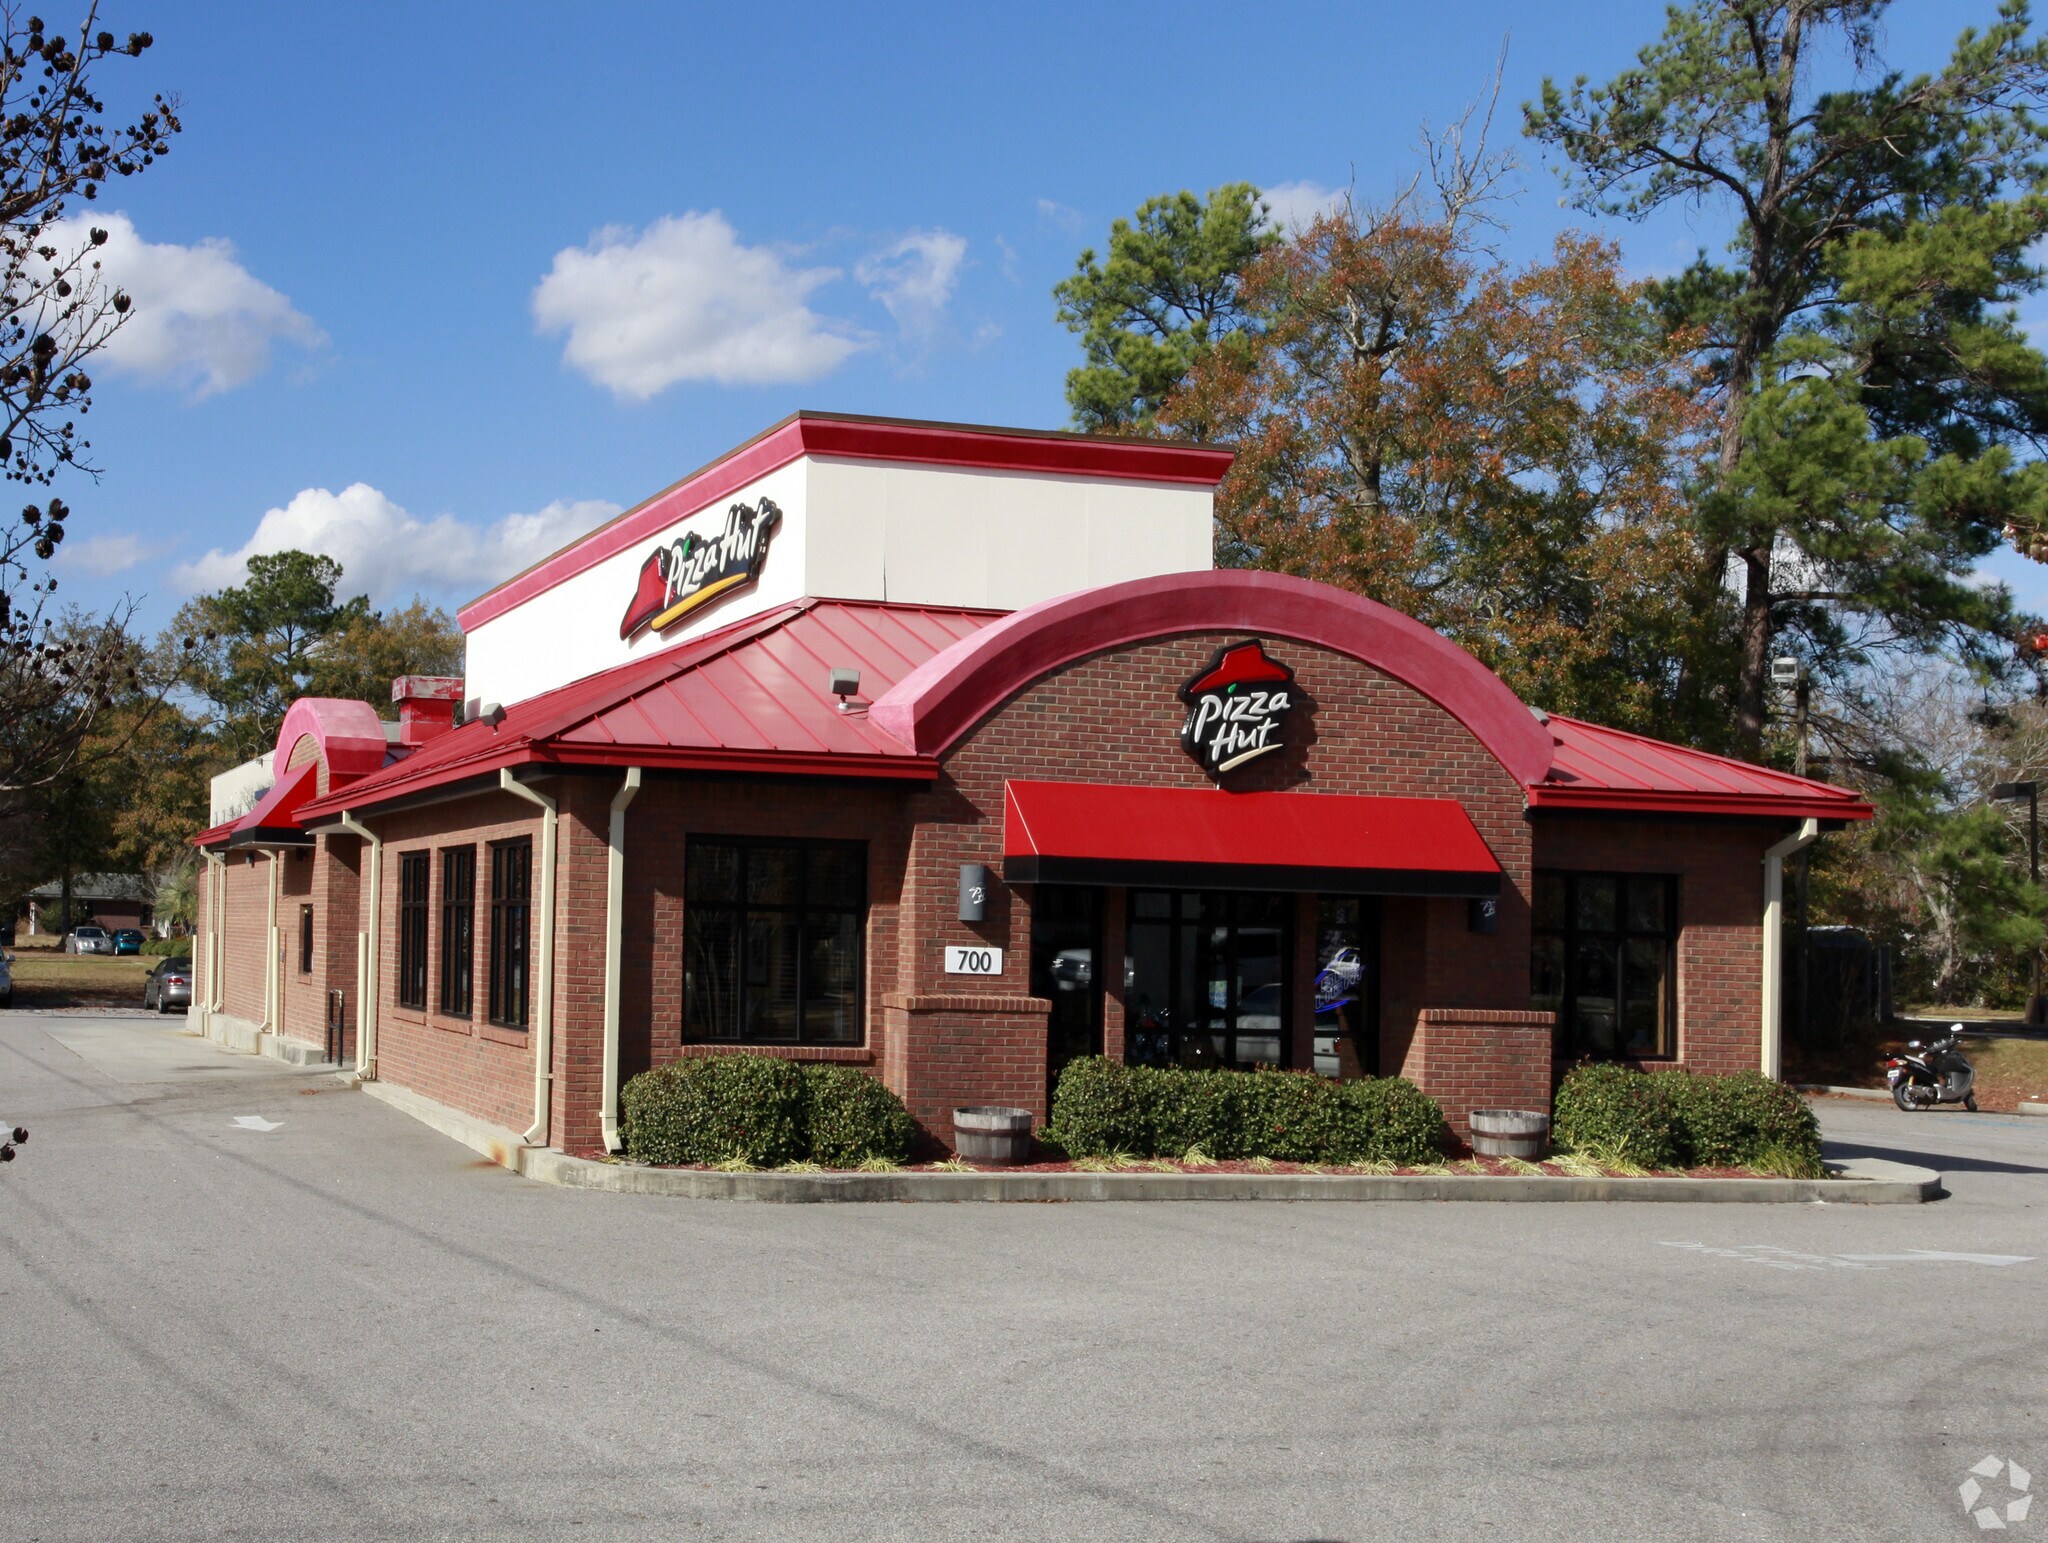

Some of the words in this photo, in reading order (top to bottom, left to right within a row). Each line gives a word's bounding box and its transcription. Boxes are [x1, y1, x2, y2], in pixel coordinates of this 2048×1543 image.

[664, 539, 718, 609] Pizza
[720, 503, 771, 573] Hut
[1194, 684, 1291, 743] Pizza
[1209, 717, 1280, 761] Hut
[958, 950, 992, 972] 700
